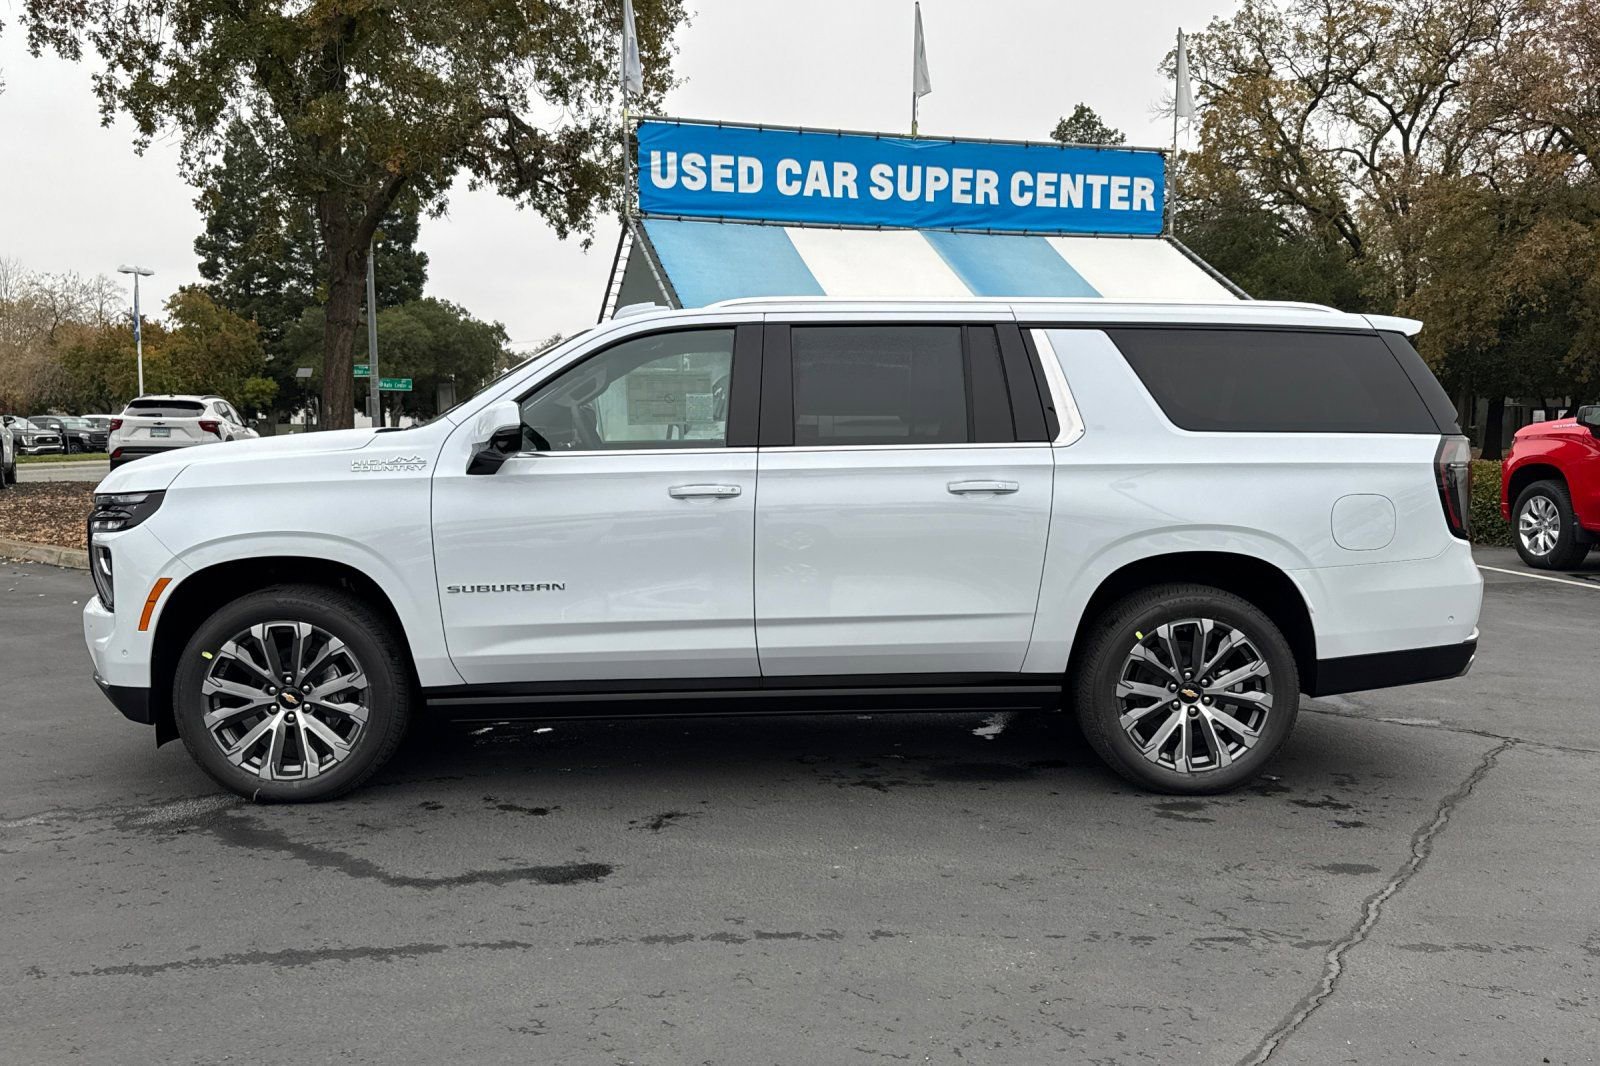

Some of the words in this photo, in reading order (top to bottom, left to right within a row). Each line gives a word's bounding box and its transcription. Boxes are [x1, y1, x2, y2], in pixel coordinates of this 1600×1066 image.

[650, 149, 764, 194] USED
[776, 158, 859, 199] CAR
[869, 163, 999, 205] SUPER
[1009, 171, 1156, 212] CENTER
[351, 458, 389, 466] HIGH
[351, 464, 427, 472] COUNTRY
[446, 582, 566, 594] SUBURBAN
